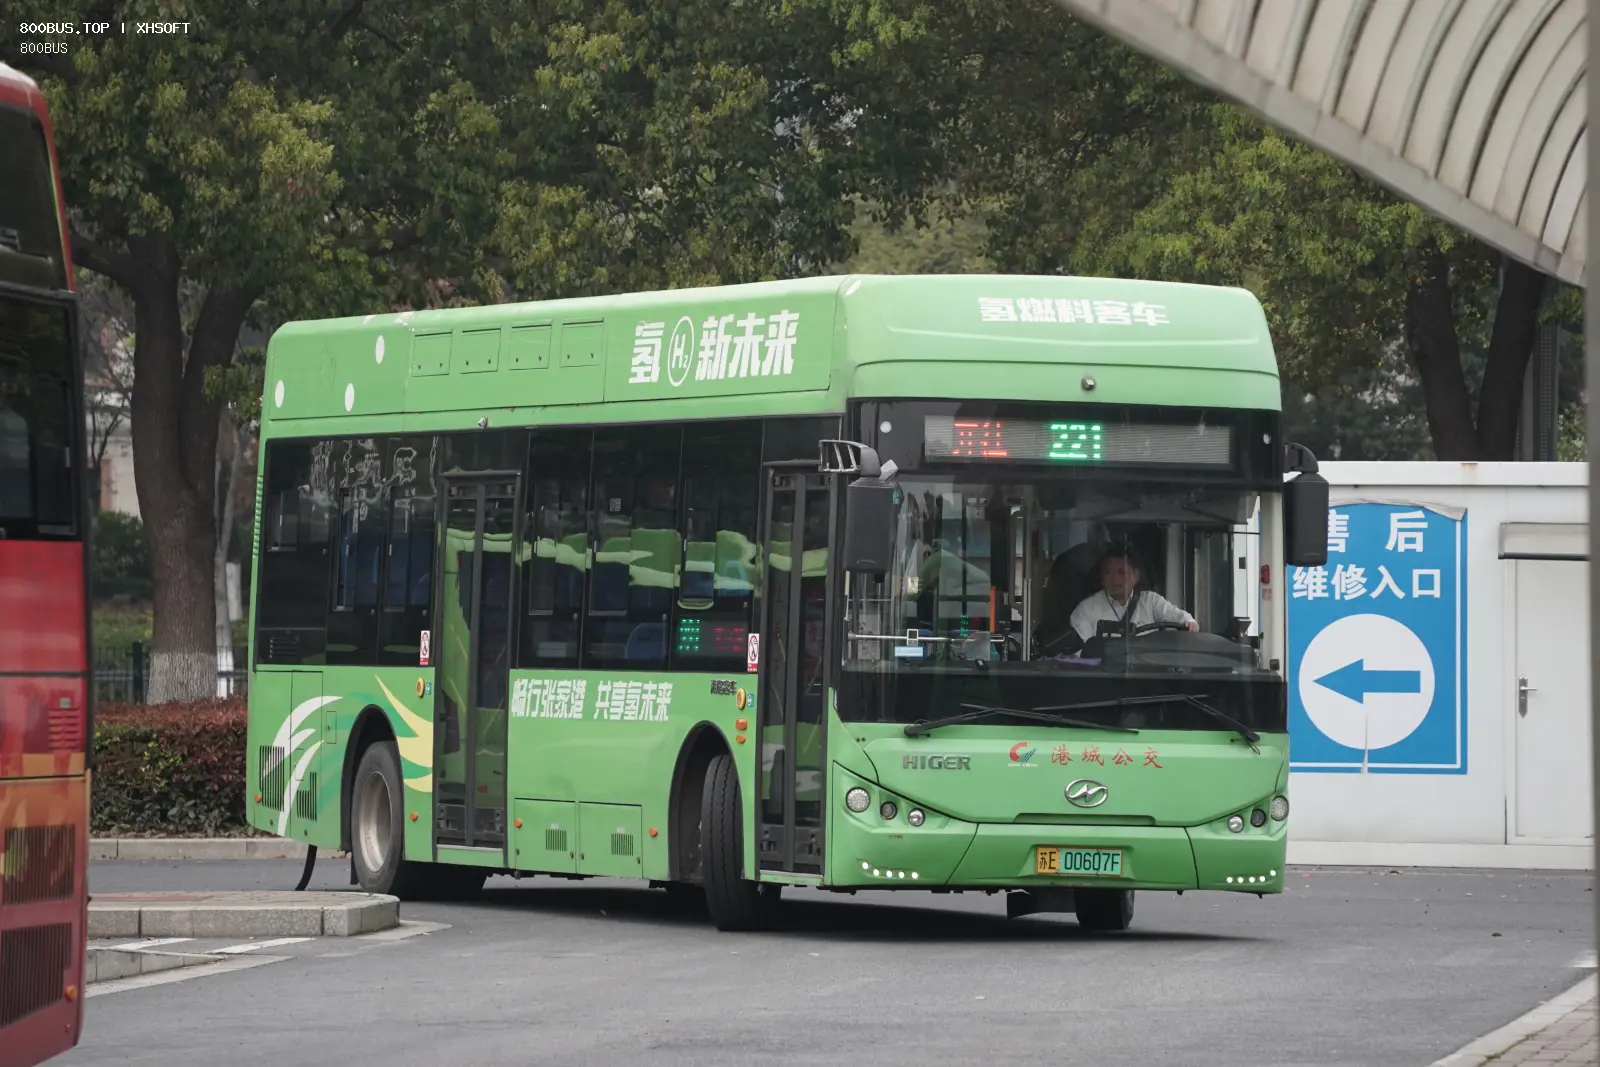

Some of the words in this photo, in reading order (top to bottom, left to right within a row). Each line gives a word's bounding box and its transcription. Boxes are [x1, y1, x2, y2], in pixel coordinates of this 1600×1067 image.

[977, 296, 1171, 326] 氢燃料客车
[628, 321, 666, 384] 氢
[694, 309, 800, 381] 新未来
[1049, 423, 1101, 460] 221
[1292, 563, 1441, 600] 维修入口
[592, 680, 674, 722] 共享氢未来
[901, 753, 972, 772] HIGER
[1050, 743, 1165, 769] 港城公交
[1039, 851, 1057, 870] 苏E
[1064, 851, 1121, 872] 00607F
